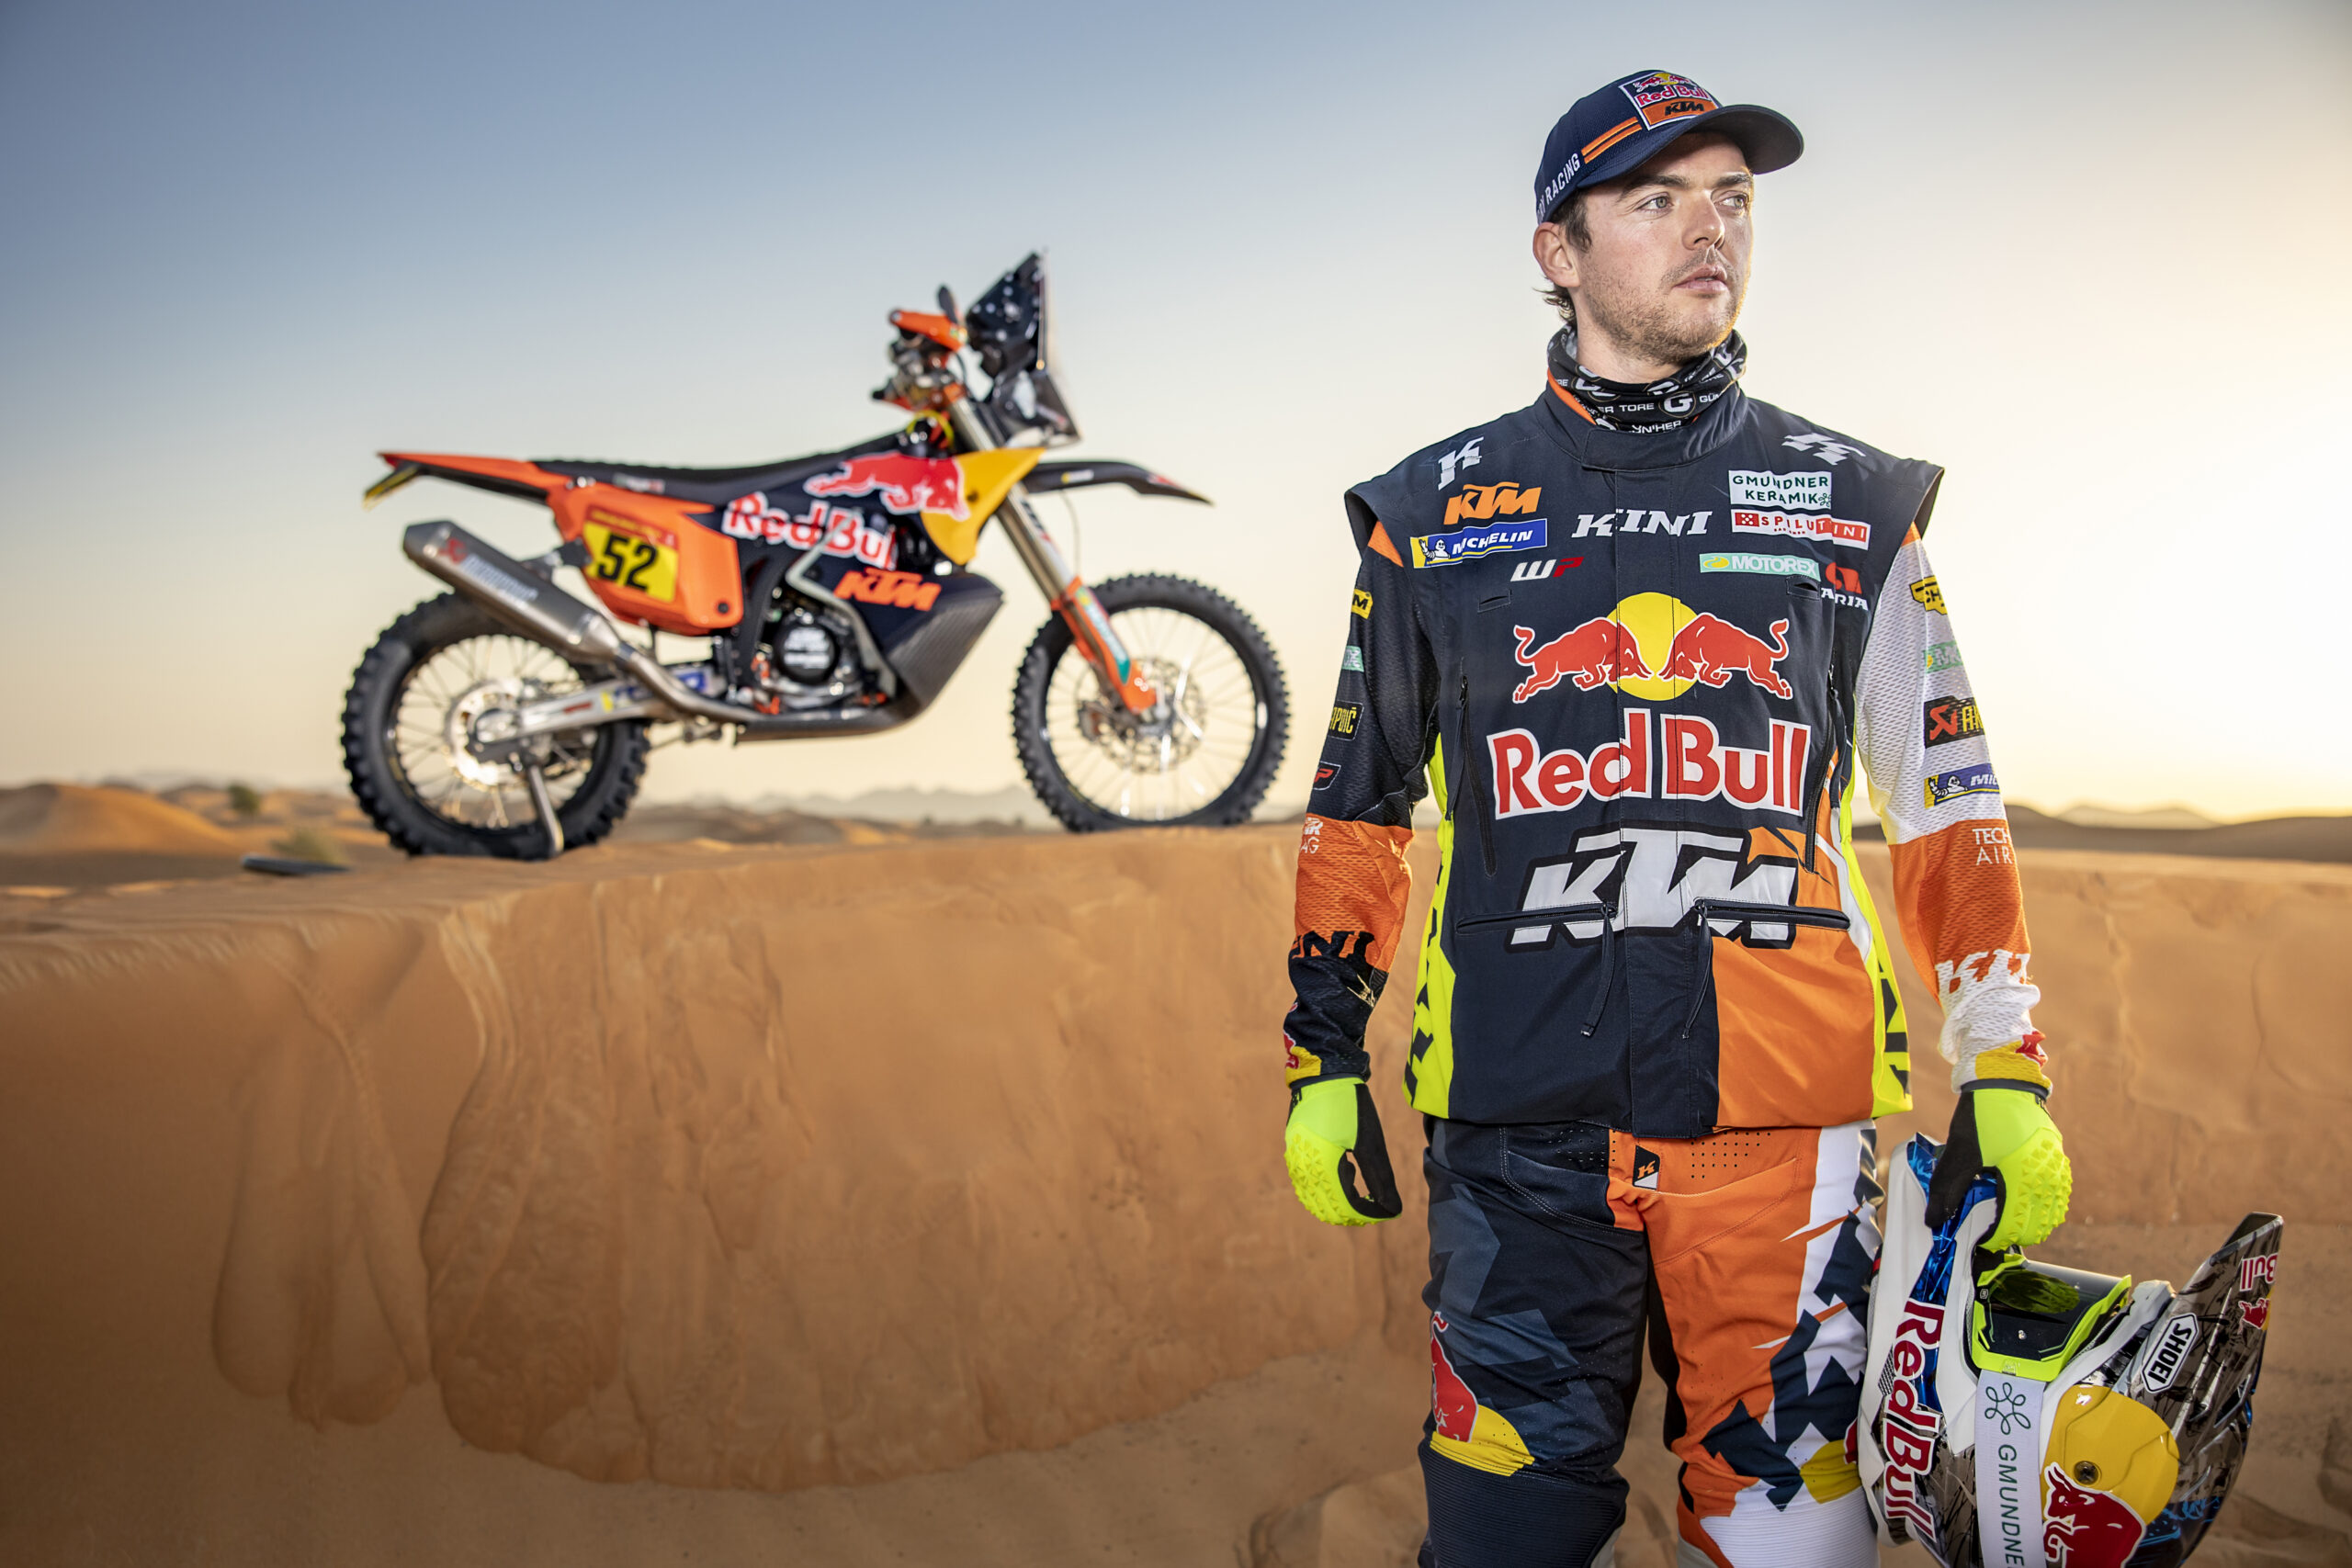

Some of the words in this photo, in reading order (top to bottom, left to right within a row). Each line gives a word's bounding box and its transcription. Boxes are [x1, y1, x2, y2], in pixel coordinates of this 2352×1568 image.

[1634, 85, 1677, 107] Red
[1674, 85, 1711, 101] Bull
[1665, 101, 1704, 116] KTM
[1545, 152, 1580, 205] RACING
[1620, 403, 1655, 412] TORE
[1732, 474, 1829, 489] GMUNDNER
[1443, 481, 1542, 525] KTM
[1745, 490, 1818, 504] KERAMIK
[721, 491, 830, 551] Red
[1571, 509, 1713, 538] KINI
[1761, 515, 1865, 539] SPILUTINI
[1452, 529, 1533, 555] MICHELIN
[596, 533, 659, 592] 52
[1510, 556, 1585, 582] WP
[1732, 555, 1818, 578] MOTOREX
[833, 567, 943, 612] KTM
[1821, 587, 1869, 611] ARIA
[1487, 708, 1652, 819] Red
[1660, 714, 1812, 817] Bull
[1975, 846, 2013, 865] AIR
[1510, 828, 1797, 945] KTM
[2239, 1253, 2278, 1292] Bull
[1884, 1297, 1946, 1435] Red
[2148, 1323, 2193, 1385] SHOEI
[1883, 1417, 1939, 1544] Bull
